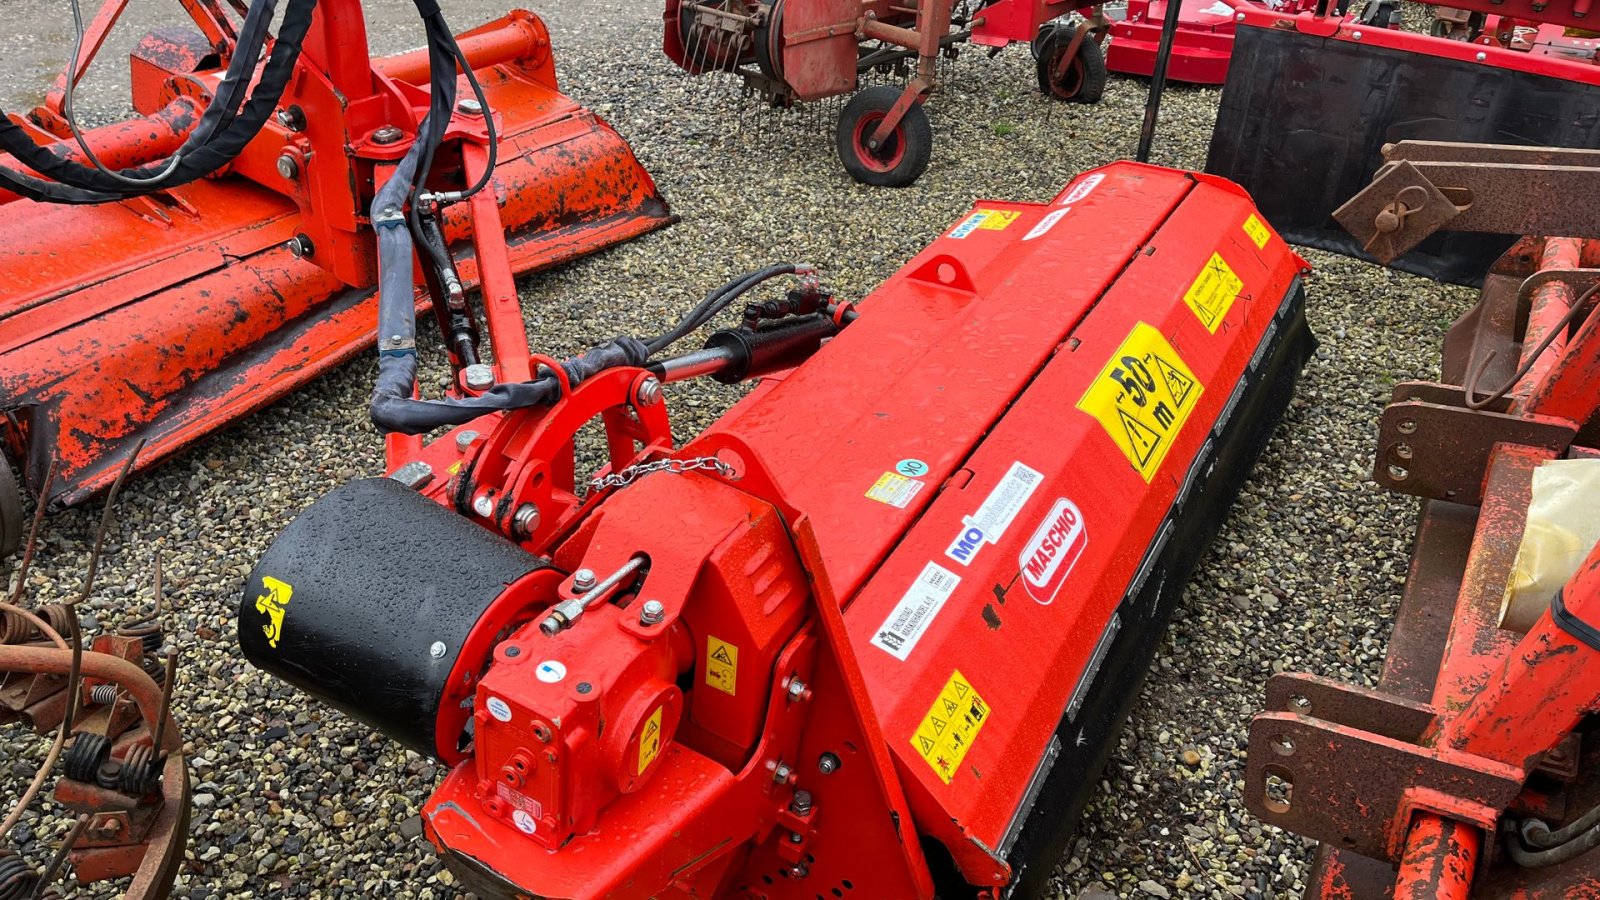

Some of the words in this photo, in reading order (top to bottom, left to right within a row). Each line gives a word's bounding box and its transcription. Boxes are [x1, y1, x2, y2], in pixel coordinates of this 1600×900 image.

[1110, 356, 1155, 407] 50
[1152, 400, 1176, 431] m
[901, 461, 923, 475] OK
[1026, 507, 1077, 581] MASCHIO
